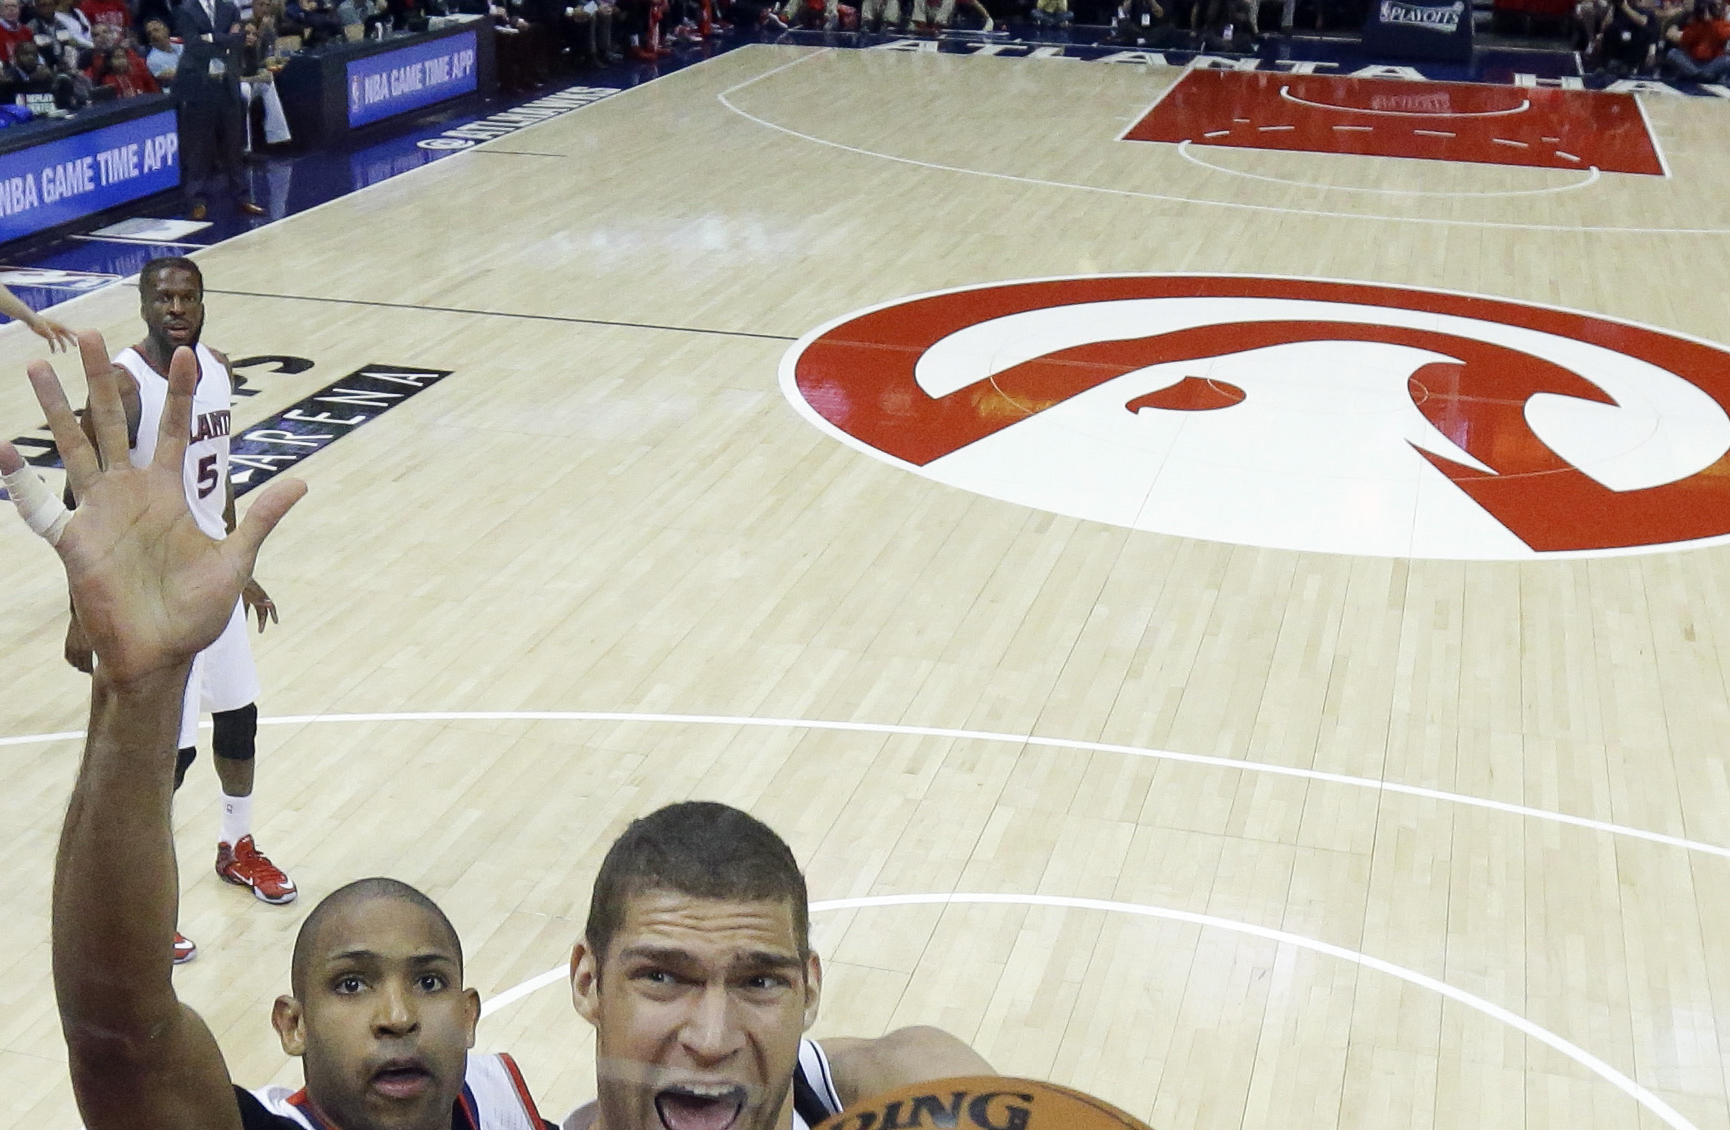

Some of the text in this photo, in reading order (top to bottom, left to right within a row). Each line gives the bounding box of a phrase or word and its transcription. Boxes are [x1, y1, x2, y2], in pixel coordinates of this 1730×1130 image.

[365, 72, 390, 105] NBA
[391, 62, 423, 96] GAME
[425, 55, 450, 87] TIME
[41, 155, 96, 204] GAME
[96, 142, 140, 187] TIME
[143, 132, 179, 174] APP
[228, 366, 441, 472] ARENA
[196, 453, 219, 500] 5
